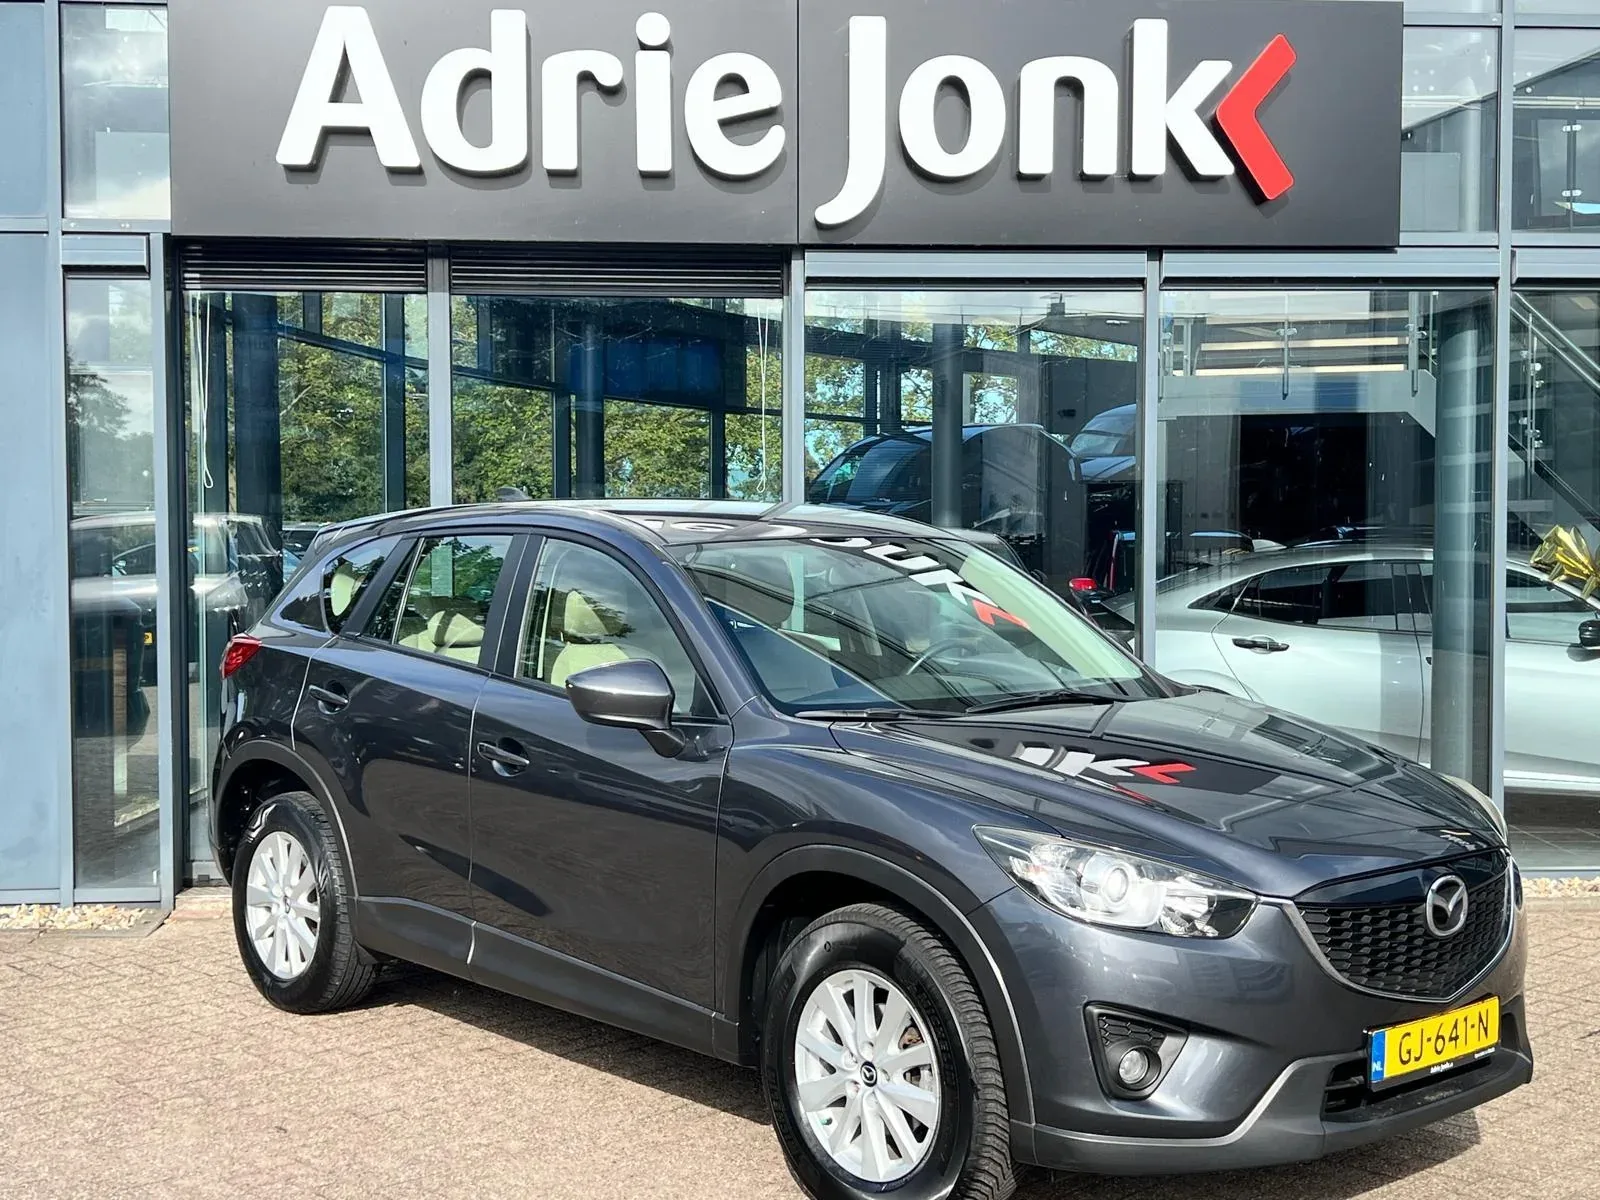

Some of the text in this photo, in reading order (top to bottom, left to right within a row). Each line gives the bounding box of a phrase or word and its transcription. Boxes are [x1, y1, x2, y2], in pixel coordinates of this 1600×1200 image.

[276, 6, 1235, 228] Adrie Jonk
[1399, 1009, 1489, 1065] GJ-641-N
[1372, 1061, 1383, 1072] NL
